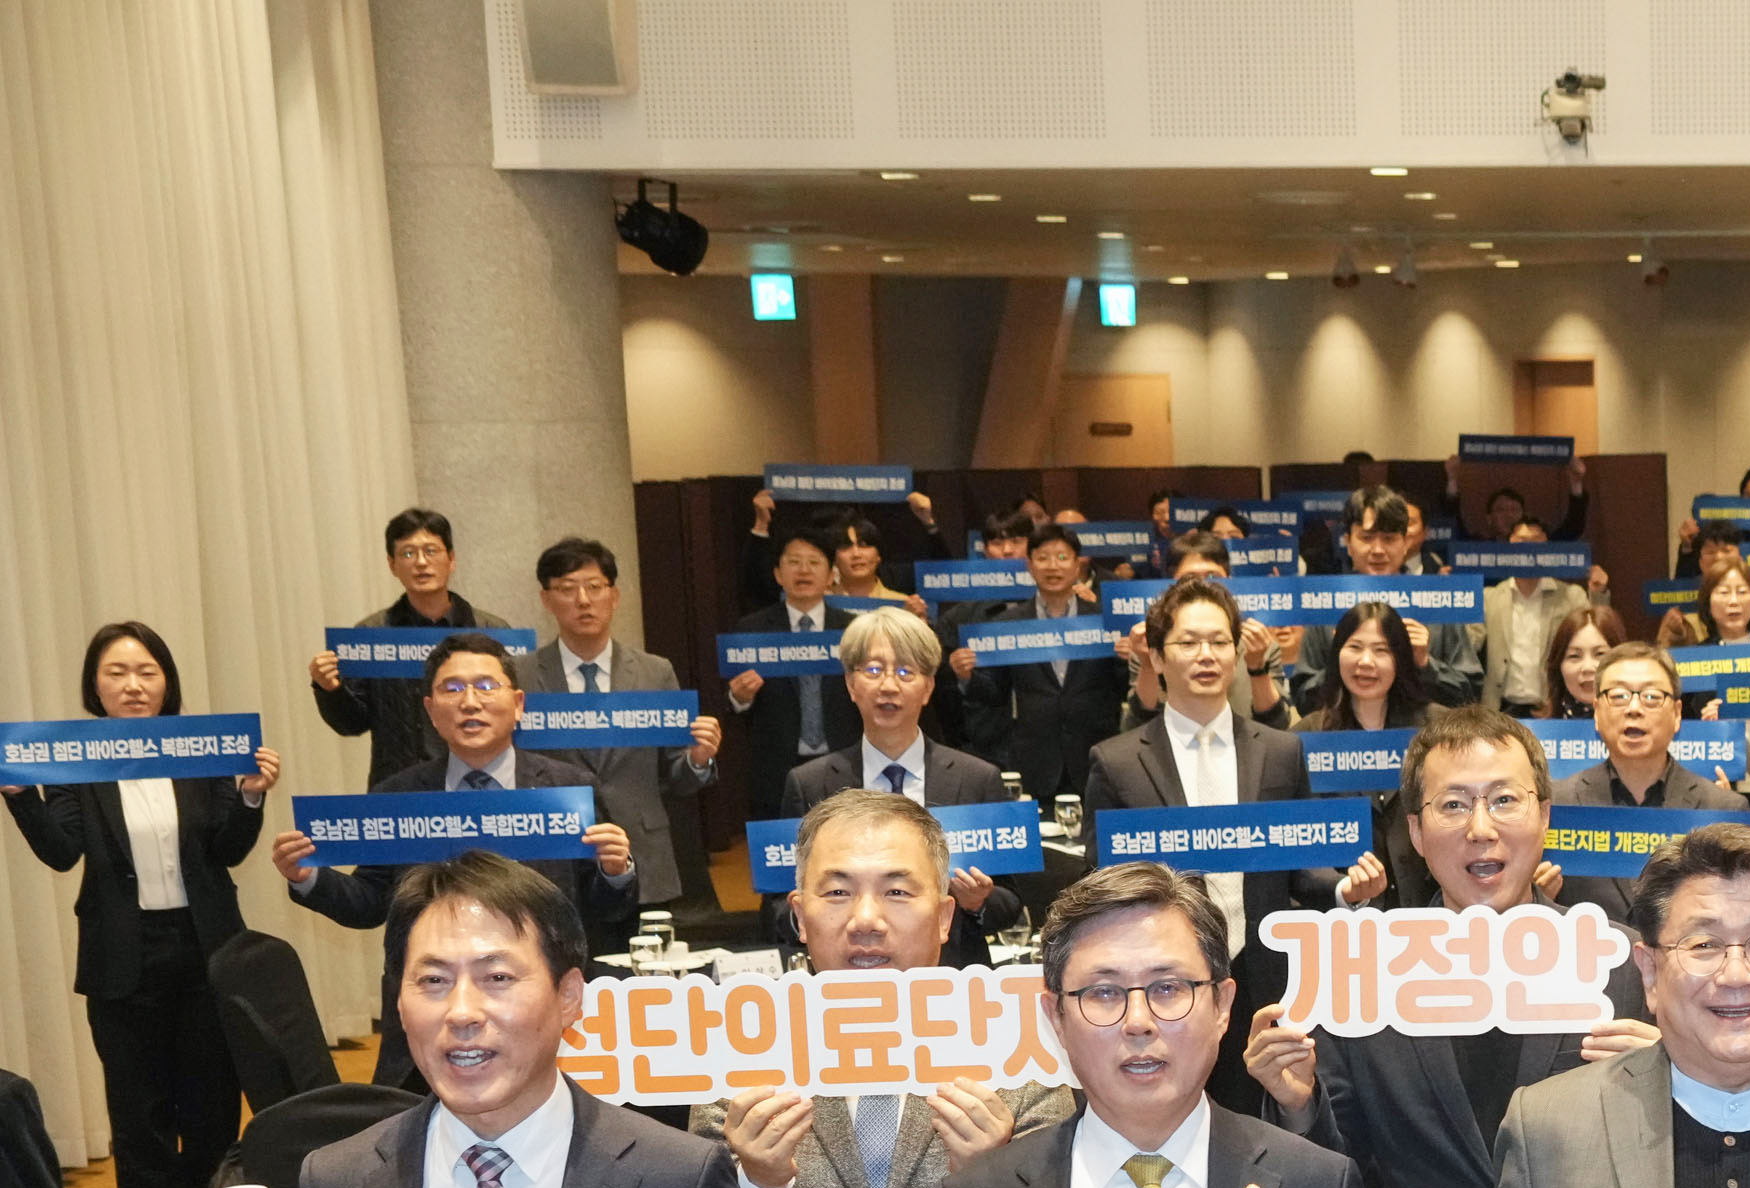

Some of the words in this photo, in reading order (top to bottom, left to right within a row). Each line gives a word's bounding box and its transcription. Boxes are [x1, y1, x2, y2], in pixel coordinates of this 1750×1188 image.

[664, 710, 688, 727] 조성
[5, 743, 49, 763] 호남권
[53, 741, 83, 762] 첨단
[86, 739, 158, 760] 바이오헬스
[161, 736, 219, 757] 복합단지
[222, 735, 250, 755] 조성
[1308, 752, 1334, 773] 첨단
[1337, 750, 1401, 772] 바이오헬스
[1560, 741, 1586, 759] 첨단
[1708, 742, 1734, 761] 조성
[310, 819, 359, 841] 호남권
[363, 817, 395, 840] 첨단
[399, 815, 478, 839] 바이오헬스
[481, 813, 545, 837] 복합단지
[549, 812, 580, 835] 조성
[1111, 832, 1156, 855] 호남권
[1160, 830, 1189, 852] 첨단
[1192, 826, 1265, 851] 바이오헬스
[1269, 823, 1326, 847] 복합단지
[1330, 821, 1359, 844] 조성
[1544, 828, 1610, 852] 료단지법
[765, 844, 797, 867] 호남
[950, 828, 993, 854] 합단지
[996, 826, 1027, 849] 조성
[1271, 914, 1617, 1024] 개정안
